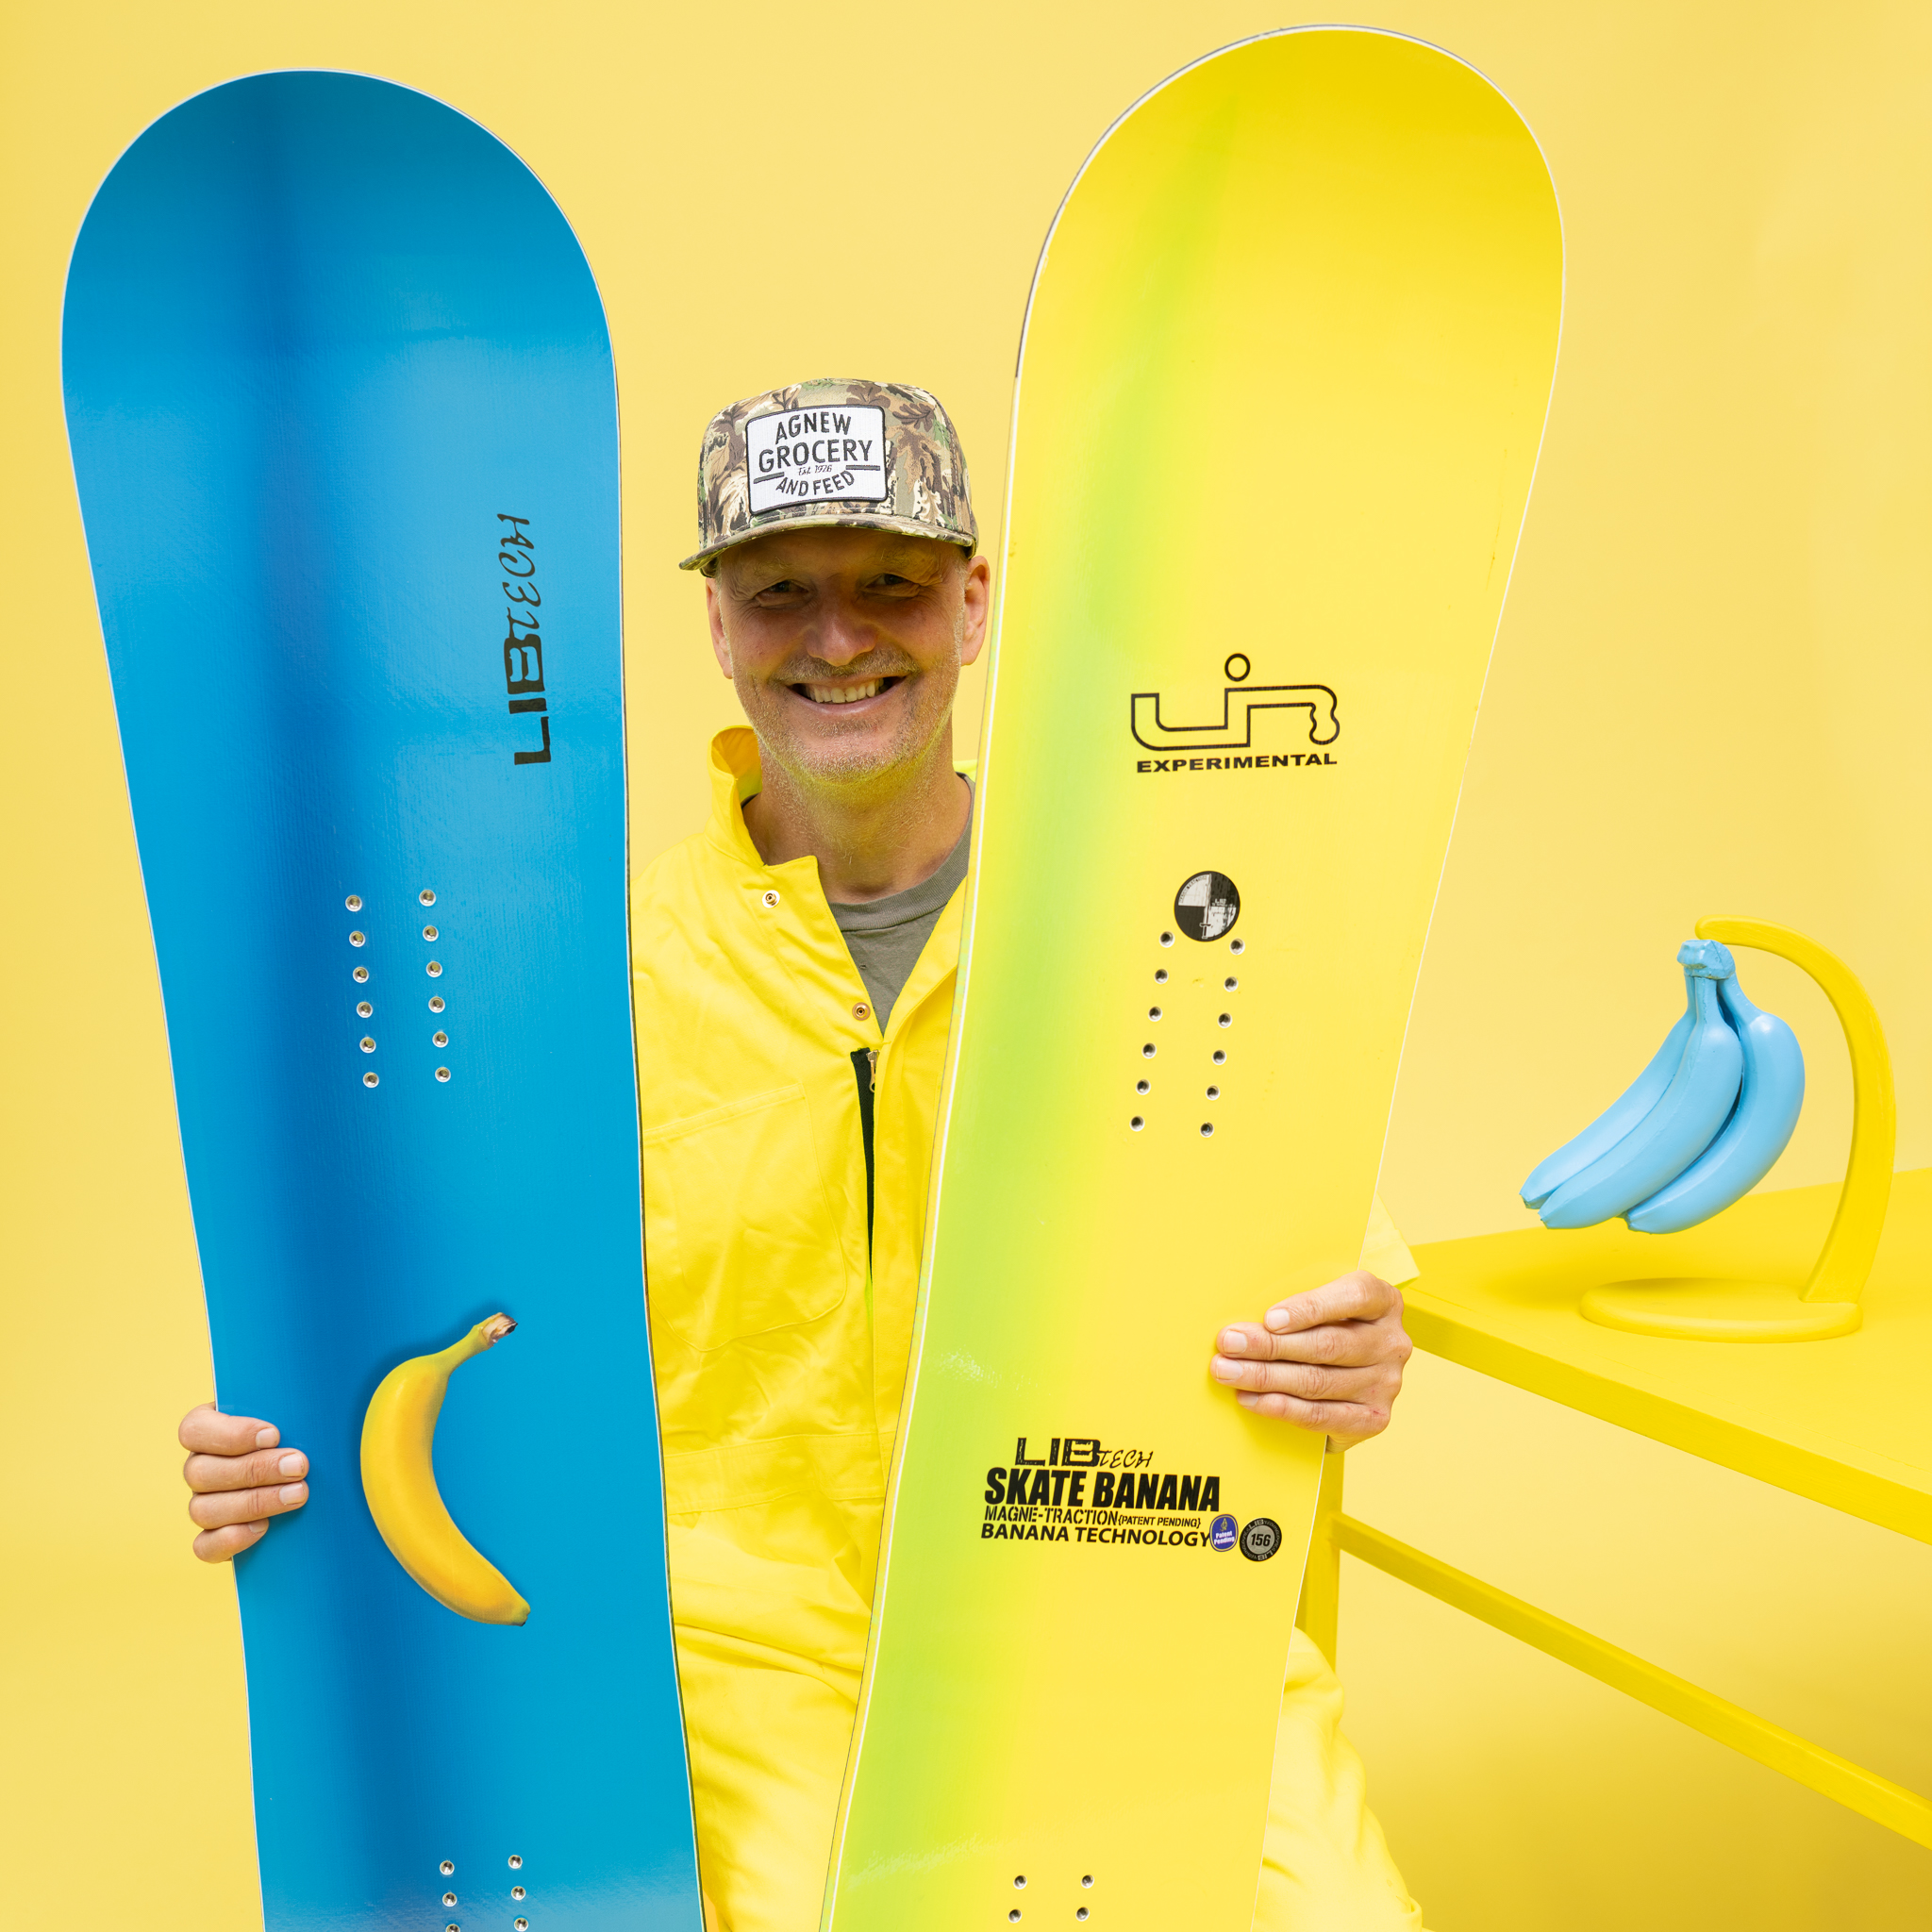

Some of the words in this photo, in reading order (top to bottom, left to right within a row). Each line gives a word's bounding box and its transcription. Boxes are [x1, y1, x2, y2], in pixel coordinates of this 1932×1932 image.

[775, 412, 852, 444] AGNEW
[758, 439, 873, 473] GROCERY
[775, 476, 809, 496] AND
[813, 471, 855, 495] FEED
[1137, 753, 1338, 774] EXPERIMENTAL
[984, 1467, 1087, 1507] SKATE
[1091, 1471, 1220, 1512] BANANA
[981, 1523, 1069, 1542] BANANA
[1074, 1526, 1210, 1548] TECHNOLOGY
[1213, 1536, 1235, 1545] Pending
[1215, 1530, 1233, 1540] Patent
[1250, 1533, 1272, 1547] 156
